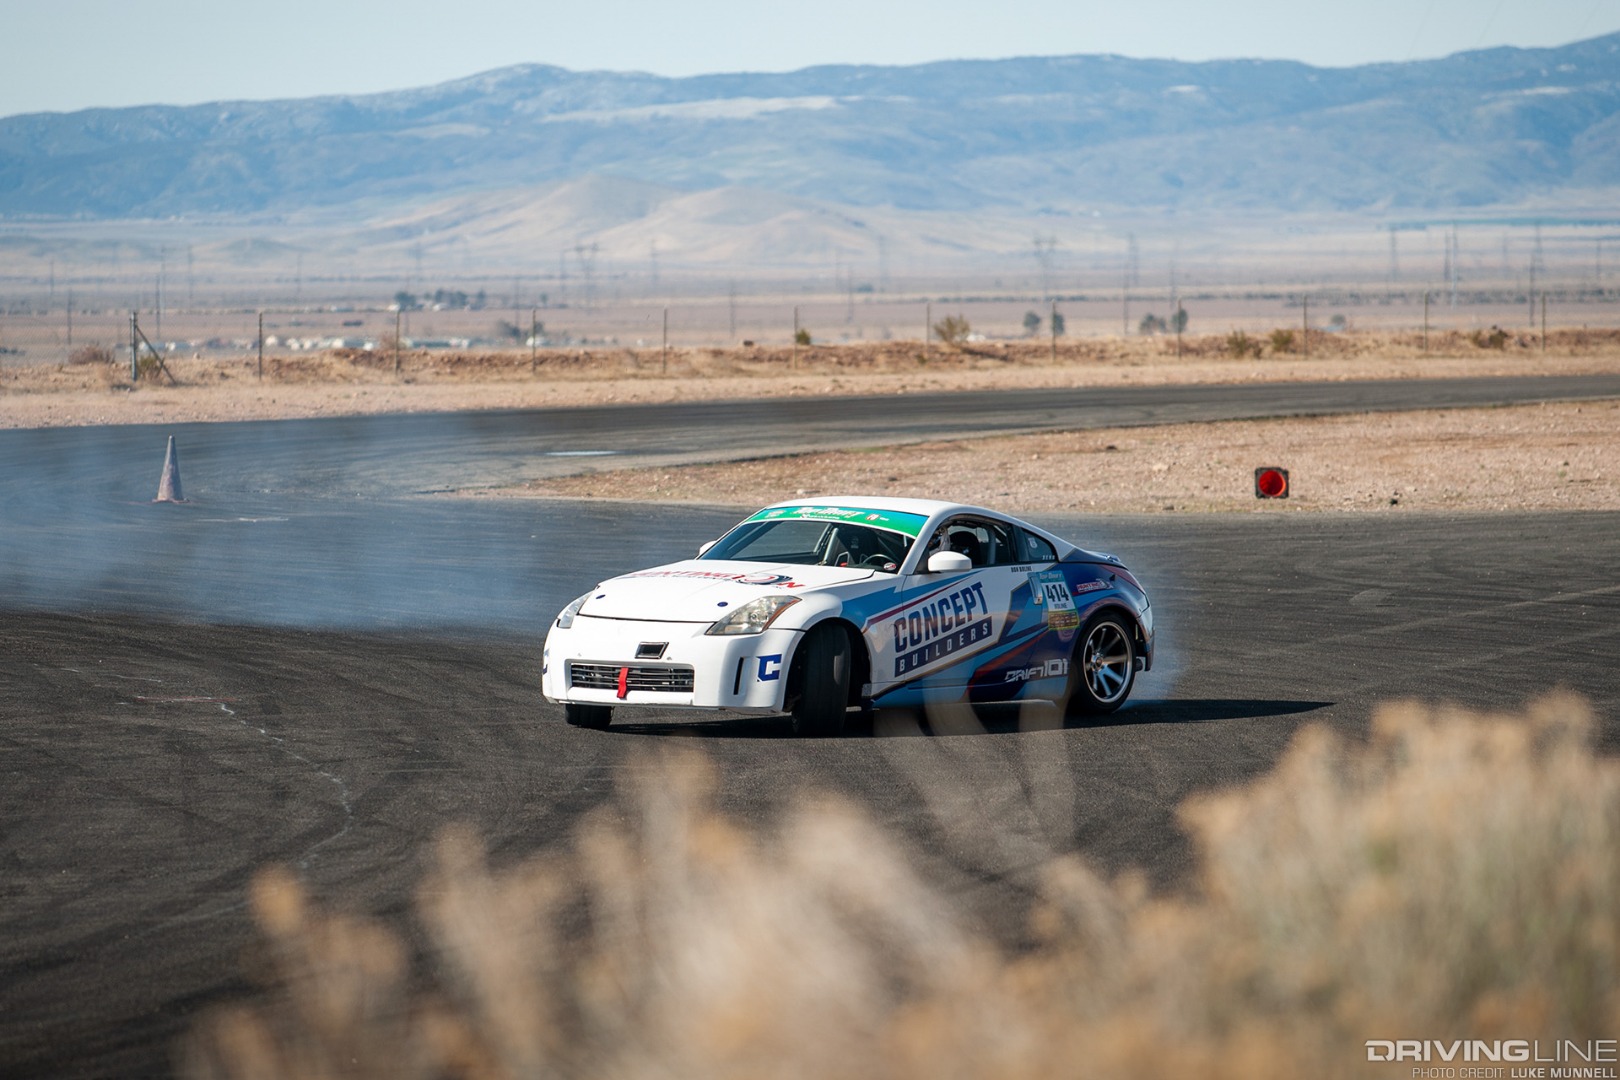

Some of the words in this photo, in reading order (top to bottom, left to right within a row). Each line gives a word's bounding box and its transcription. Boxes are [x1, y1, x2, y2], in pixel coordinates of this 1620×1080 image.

[894, 581, 988, 653] CONCEPT
[1045, 583, 1070, 602] 414
[899, 622, 988, 672] BUILDERS
